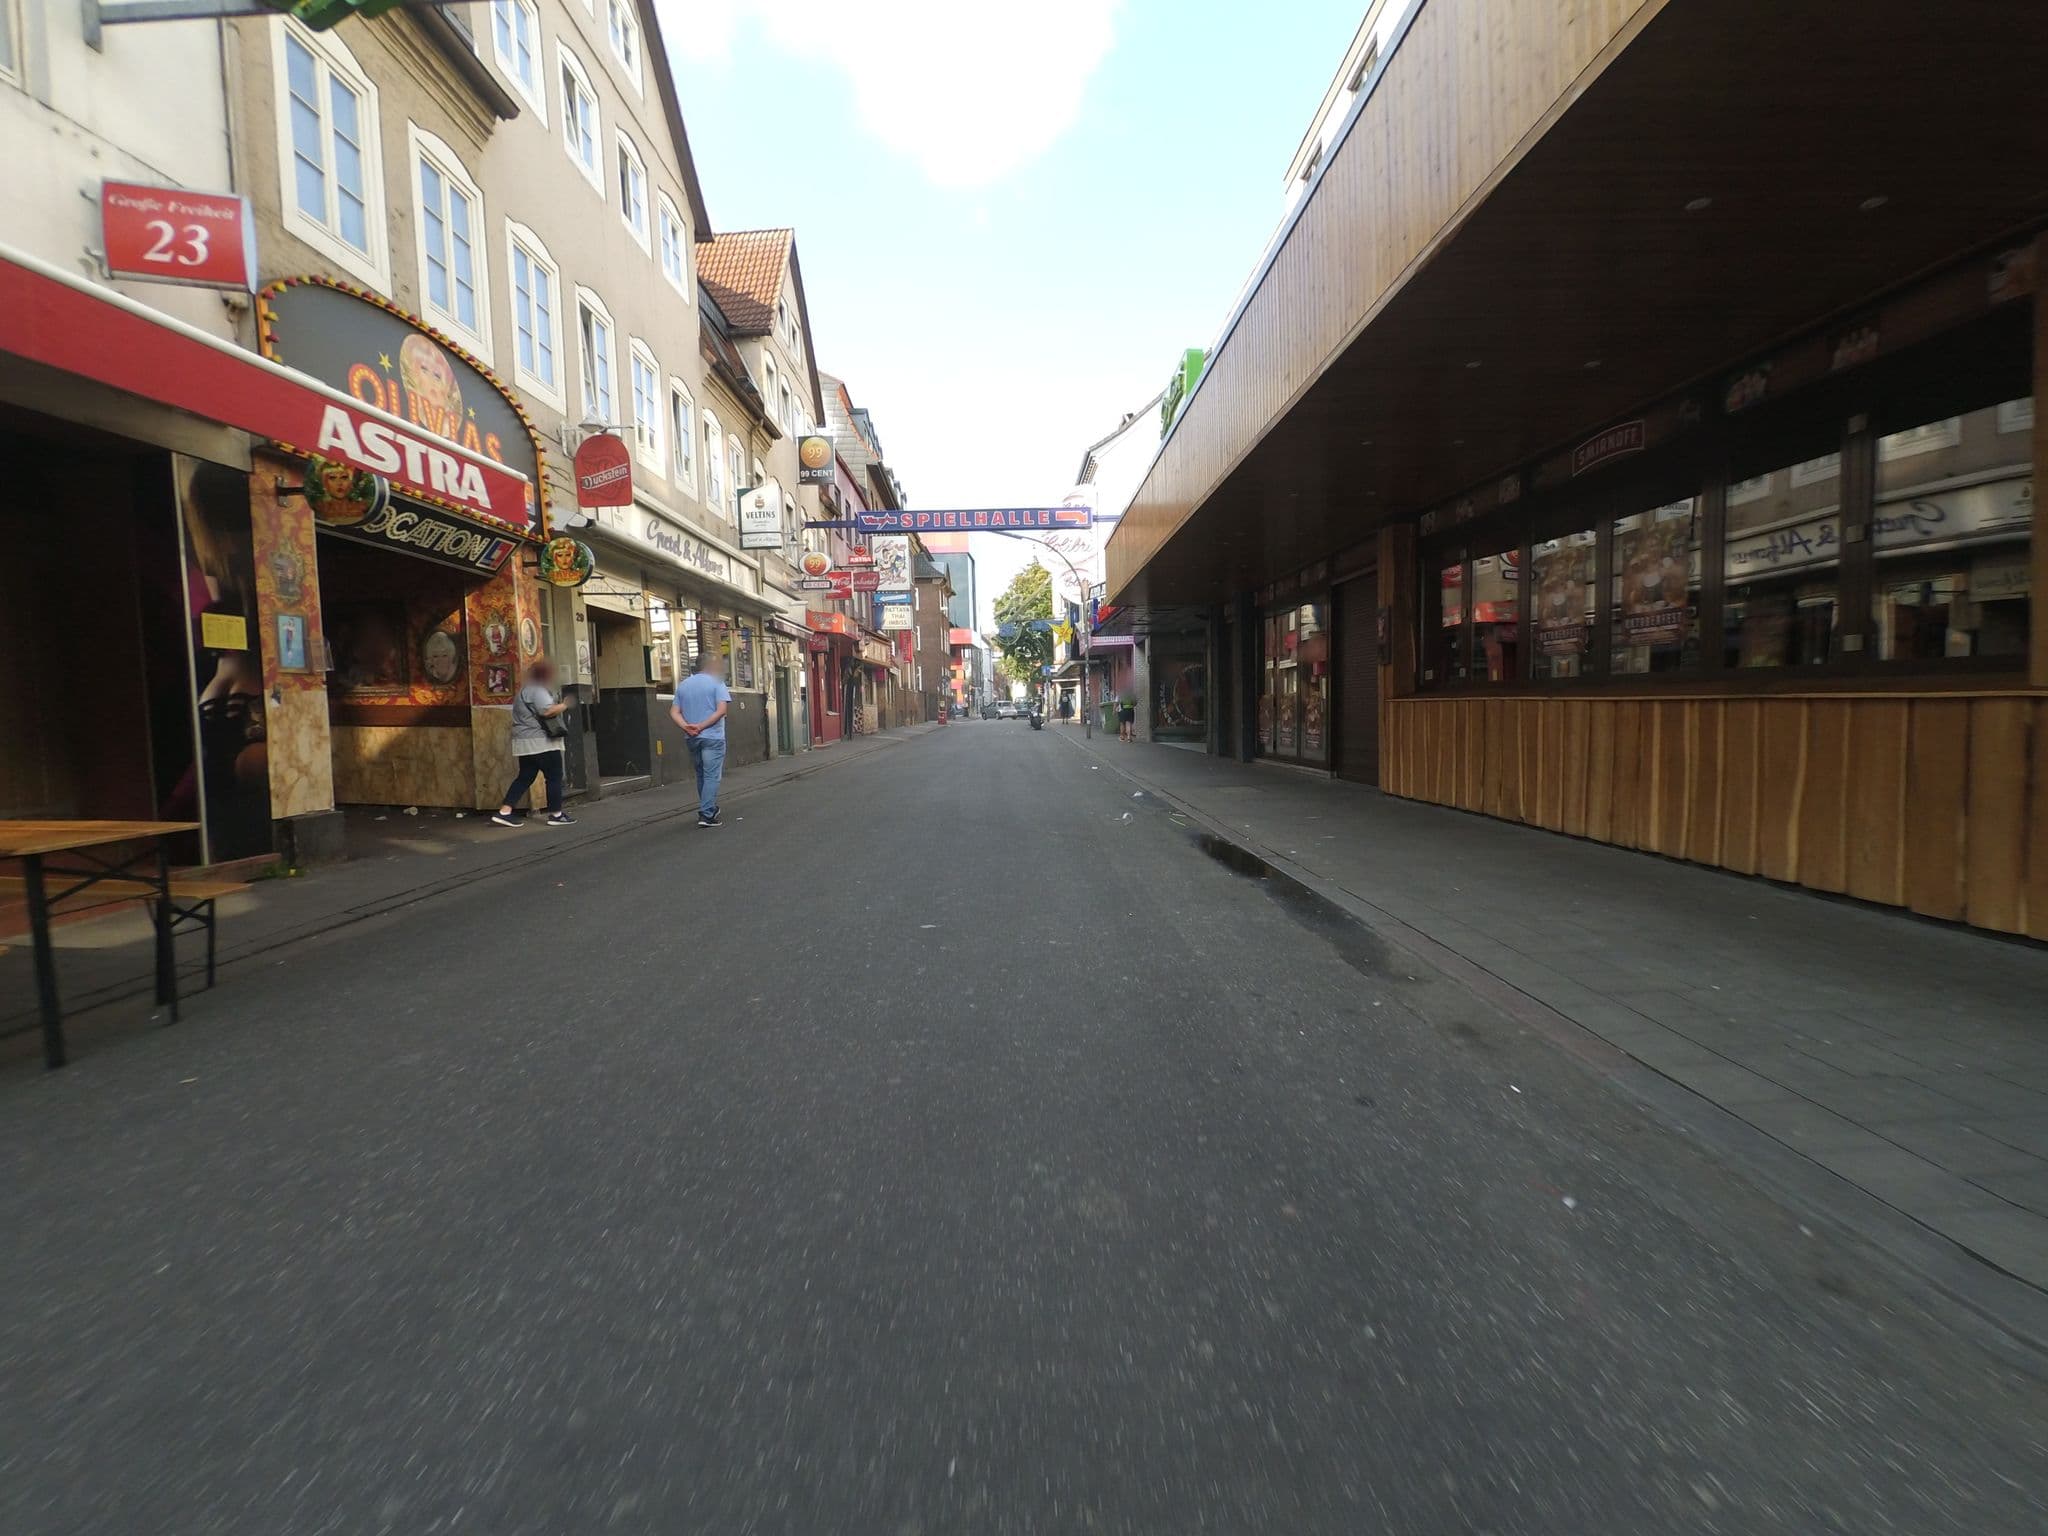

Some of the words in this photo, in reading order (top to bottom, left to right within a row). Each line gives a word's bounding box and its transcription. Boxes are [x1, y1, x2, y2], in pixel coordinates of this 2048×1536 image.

[143, 219, 210, 266] 23
[318, 404, 493, 510] ASTRA
[1577, 426, 1639, 466] SMIRNOFF
[583, 467, 628, 489] Duckstein
[811, 469, 834, 477] CENT
[745, 510, 776, 519] VELTINS
[900, 510, 1050, 527] SPIELHALLE
[362, 504, 491, 562] OCATION
